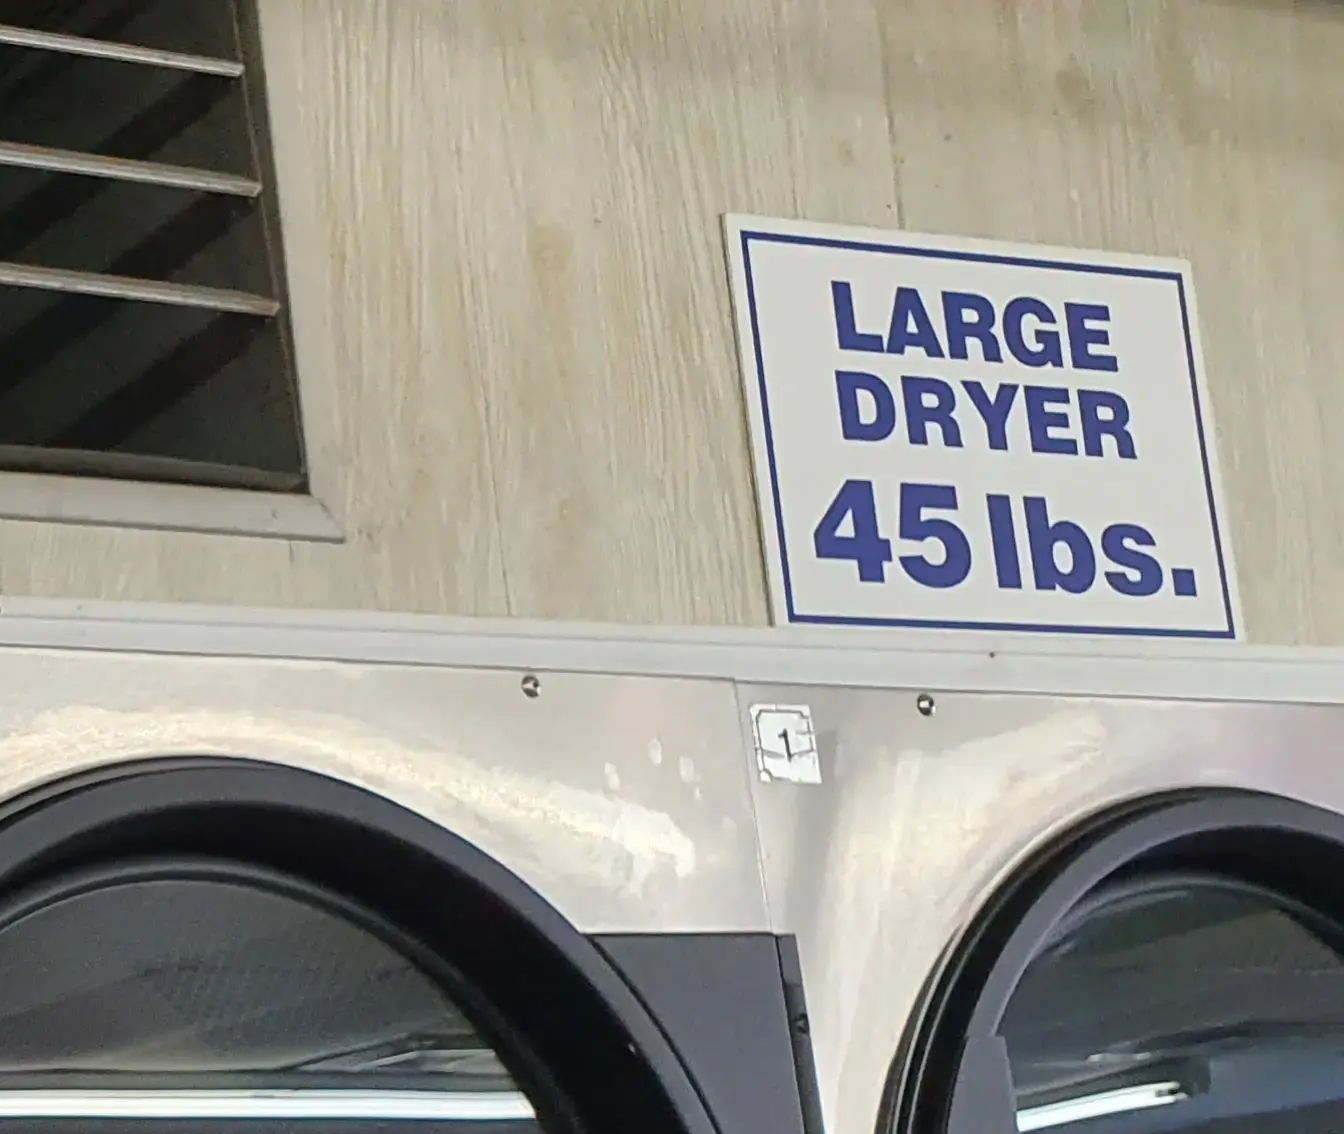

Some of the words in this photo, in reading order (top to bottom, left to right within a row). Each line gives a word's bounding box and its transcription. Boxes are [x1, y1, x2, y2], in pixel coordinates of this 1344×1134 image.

[831, 280, 1118, 372] LARGE
[834, 370, 1136, 458] DRYER
[814, 479, 971, 588] 45
[986, 493, 1197, 597] lbs.
[778, 728, 792, 762] 1
